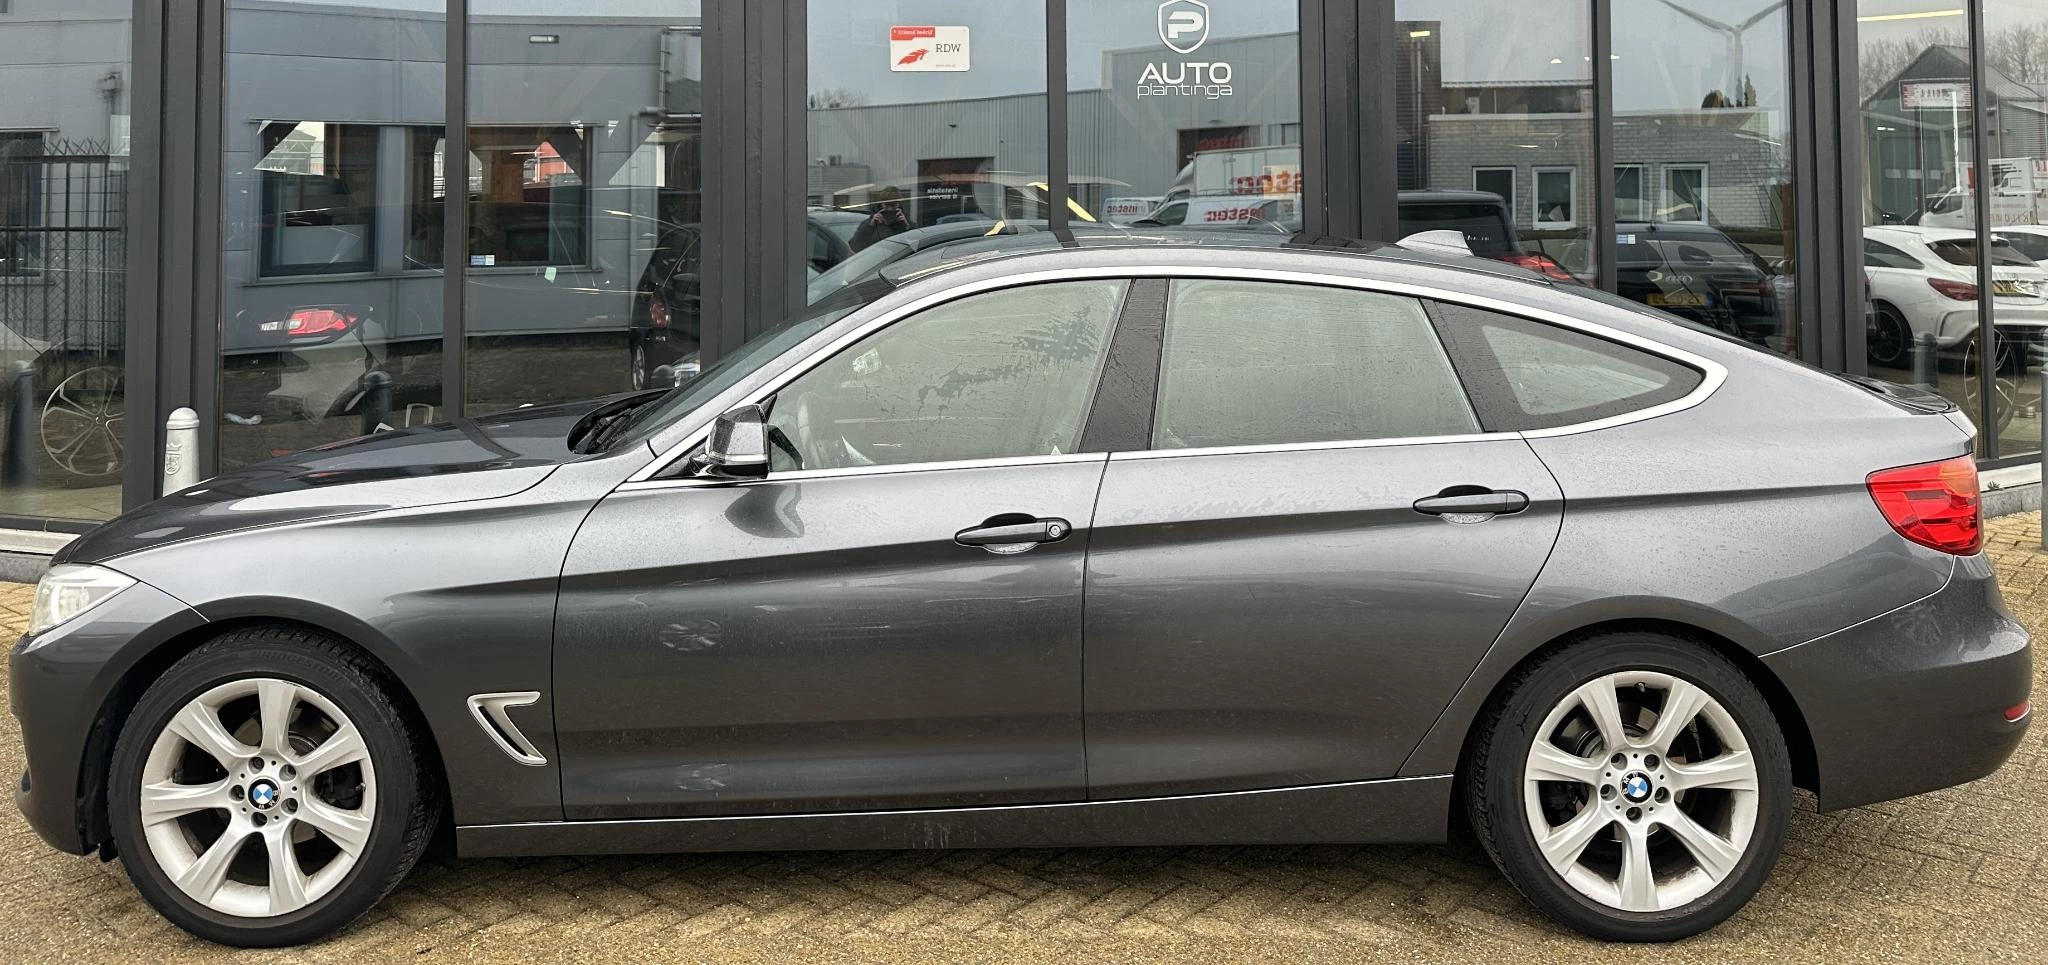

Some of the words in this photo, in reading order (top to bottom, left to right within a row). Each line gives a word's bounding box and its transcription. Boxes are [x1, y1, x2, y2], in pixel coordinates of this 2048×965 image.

[935, 43, 961, 53] RDW
[1138, 62, 1232, 84] AUTO
[1137, 83, 1233, 100] plantinga
[258, 790, 279, 809] BMW
